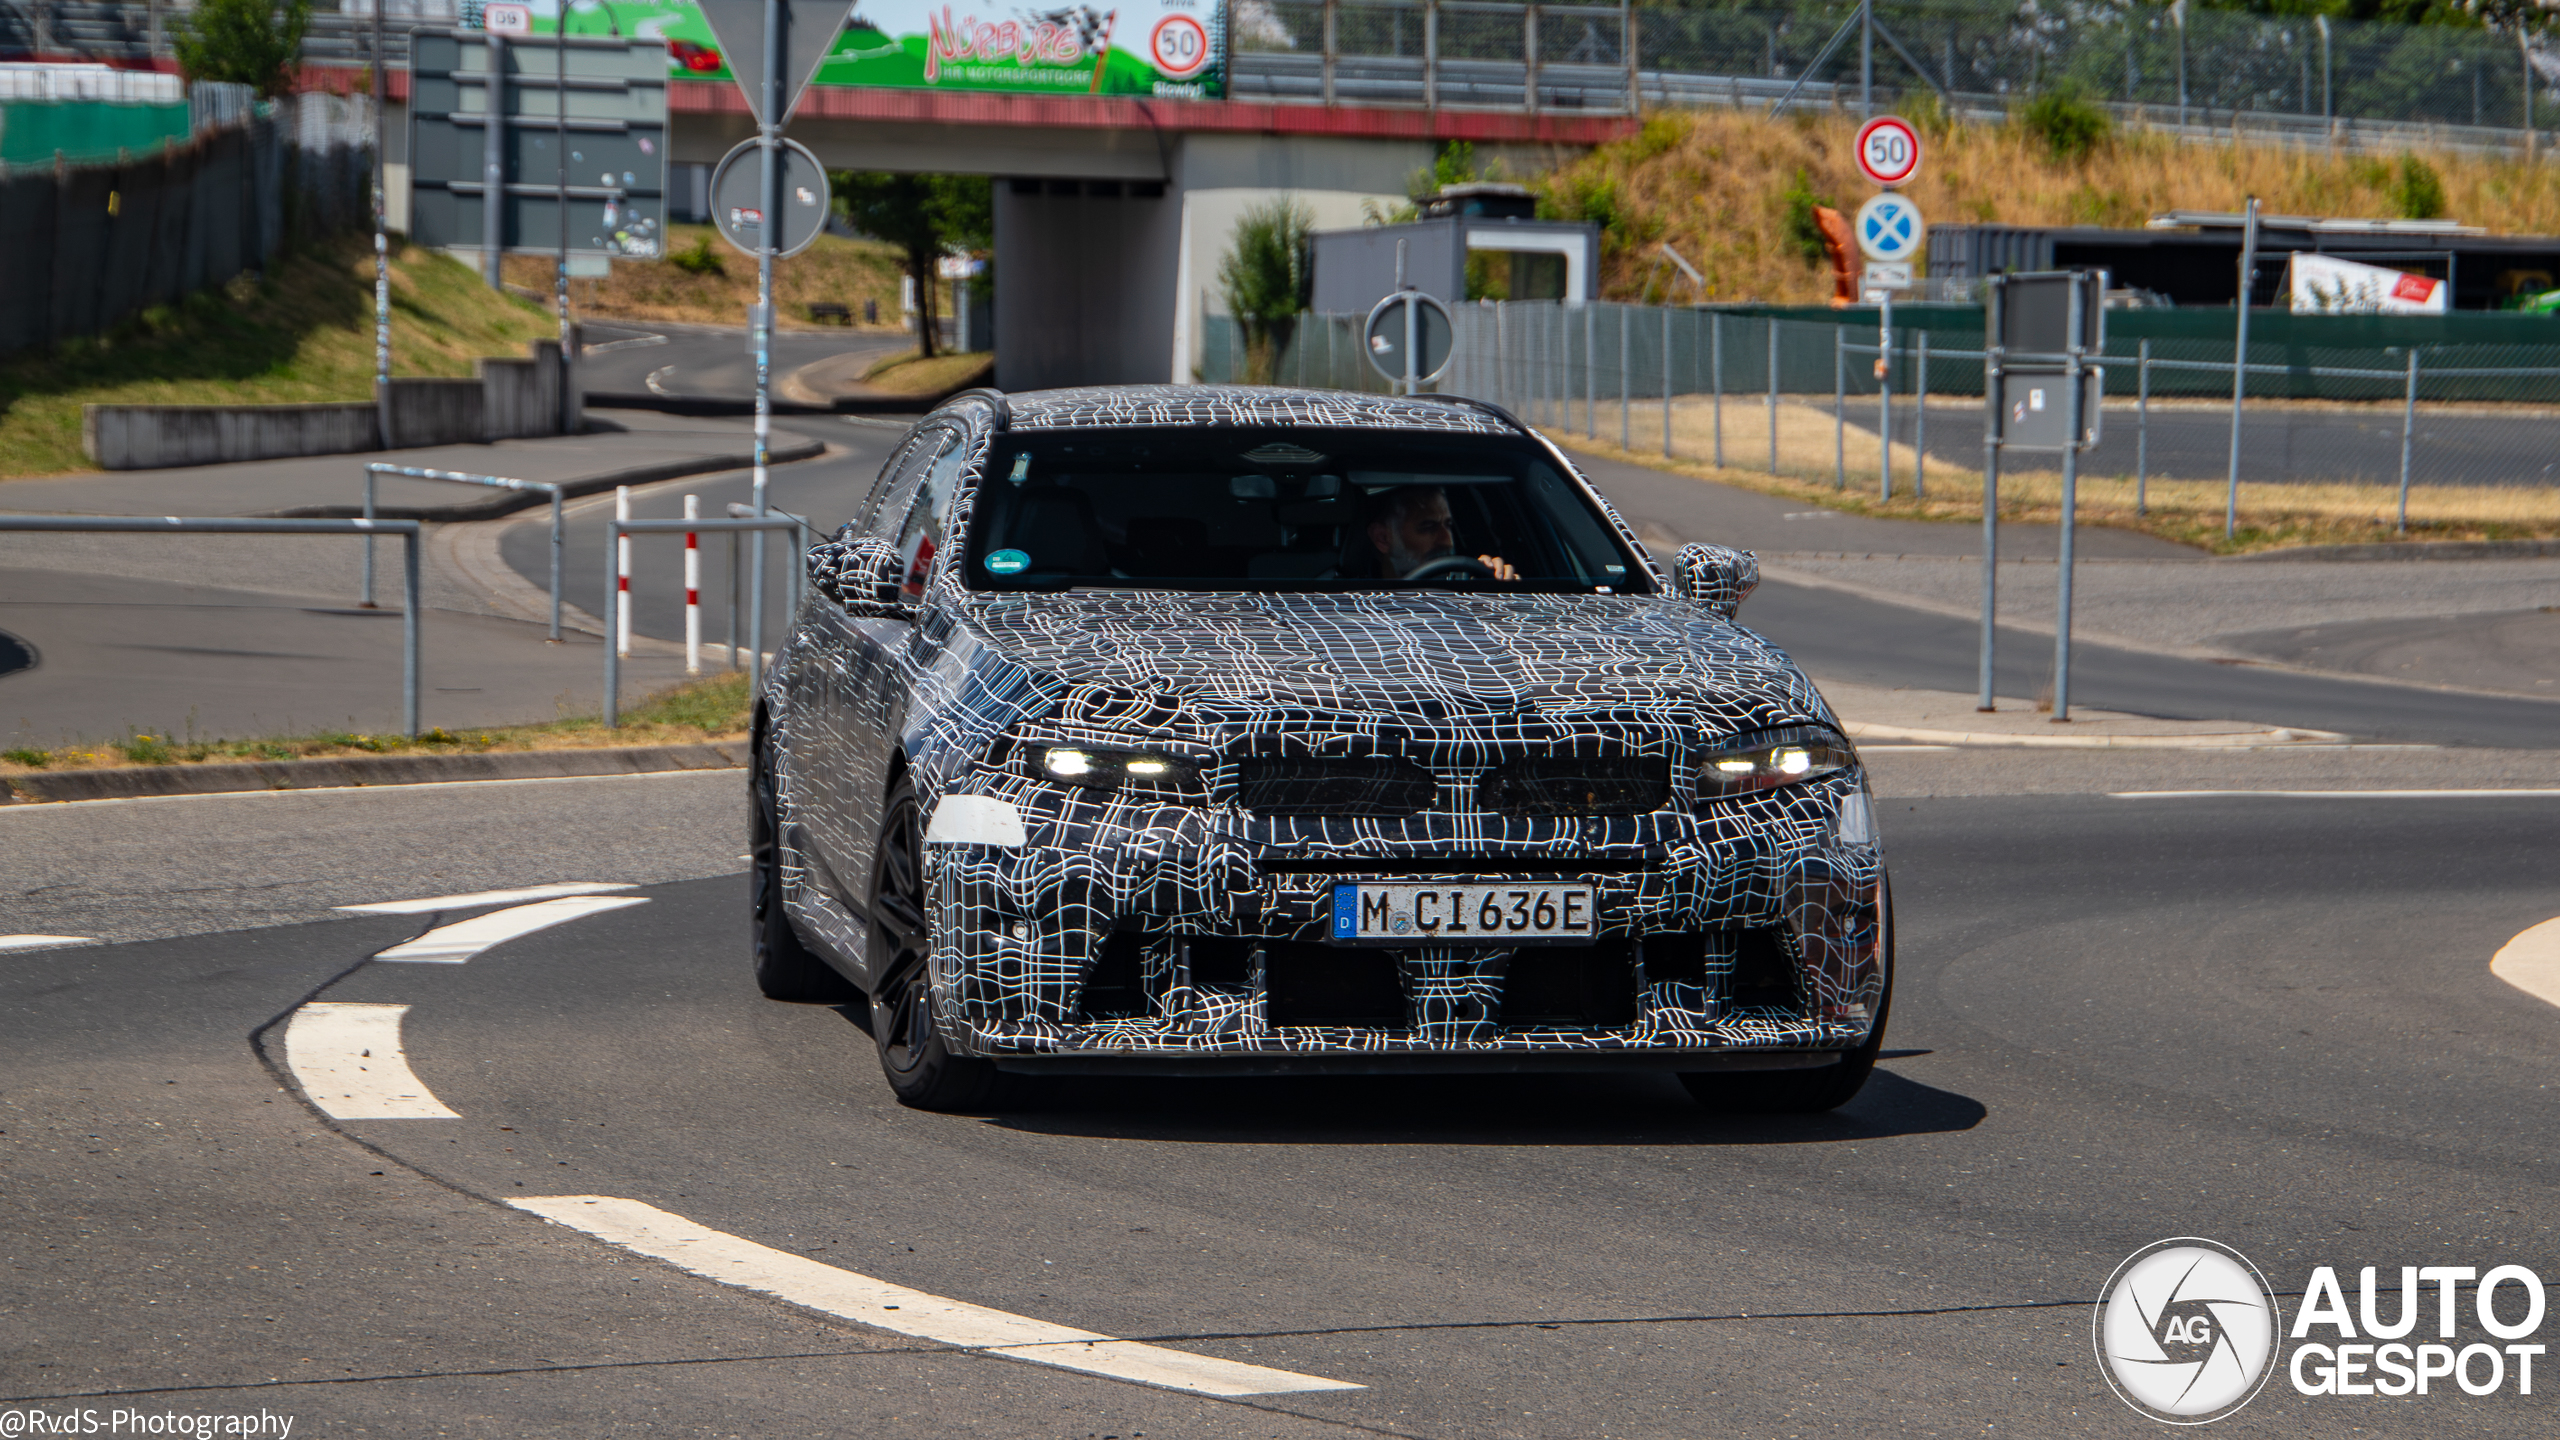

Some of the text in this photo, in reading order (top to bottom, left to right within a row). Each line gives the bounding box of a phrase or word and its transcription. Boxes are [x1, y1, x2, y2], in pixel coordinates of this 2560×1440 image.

[924, 2, 1083, 84] NÜRBURG
[1162, 28, 1194, 56] 50
[966, 67, 1092, 84] MOTORSPORTDORF
[1871, 135, 1905, 163] 50
[1340, 890, 1588, 931] D M CI 636E
